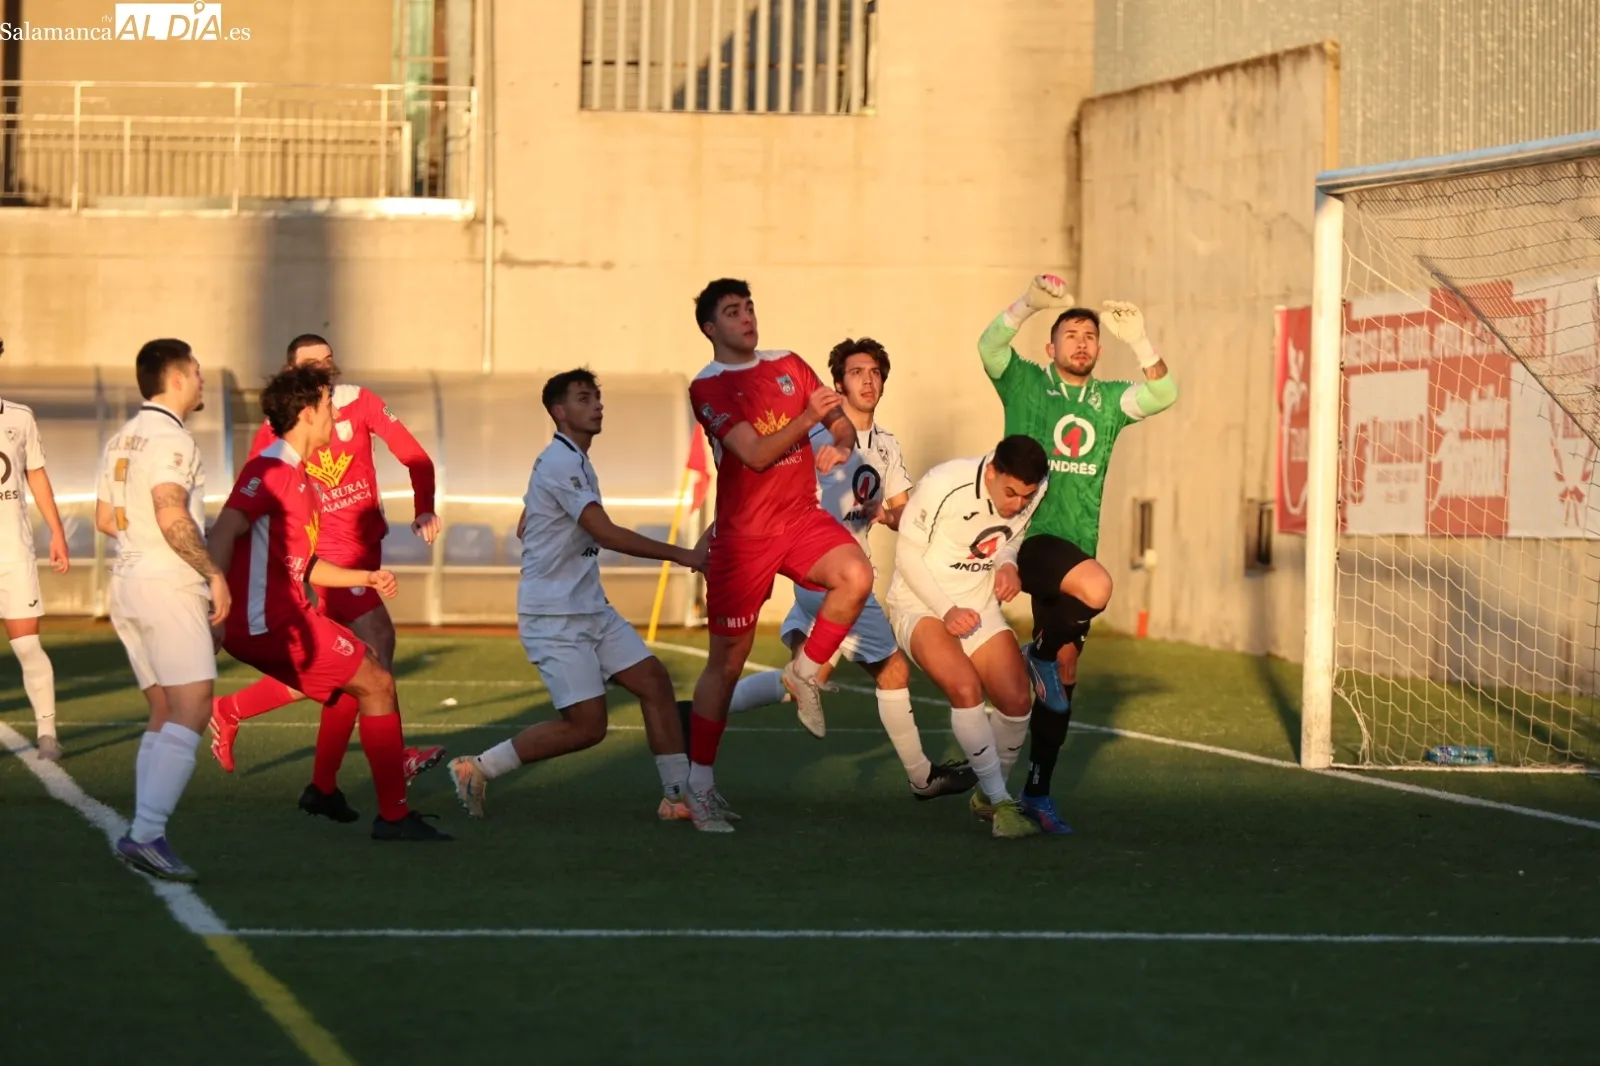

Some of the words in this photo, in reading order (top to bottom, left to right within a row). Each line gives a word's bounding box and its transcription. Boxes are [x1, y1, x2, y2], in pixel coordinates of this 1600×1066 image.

[330, 478, 370, 501] RURAL
[321, 491, 372, 514] ALAMANCA
[949, 559, 994, 573] ANDRÉ
